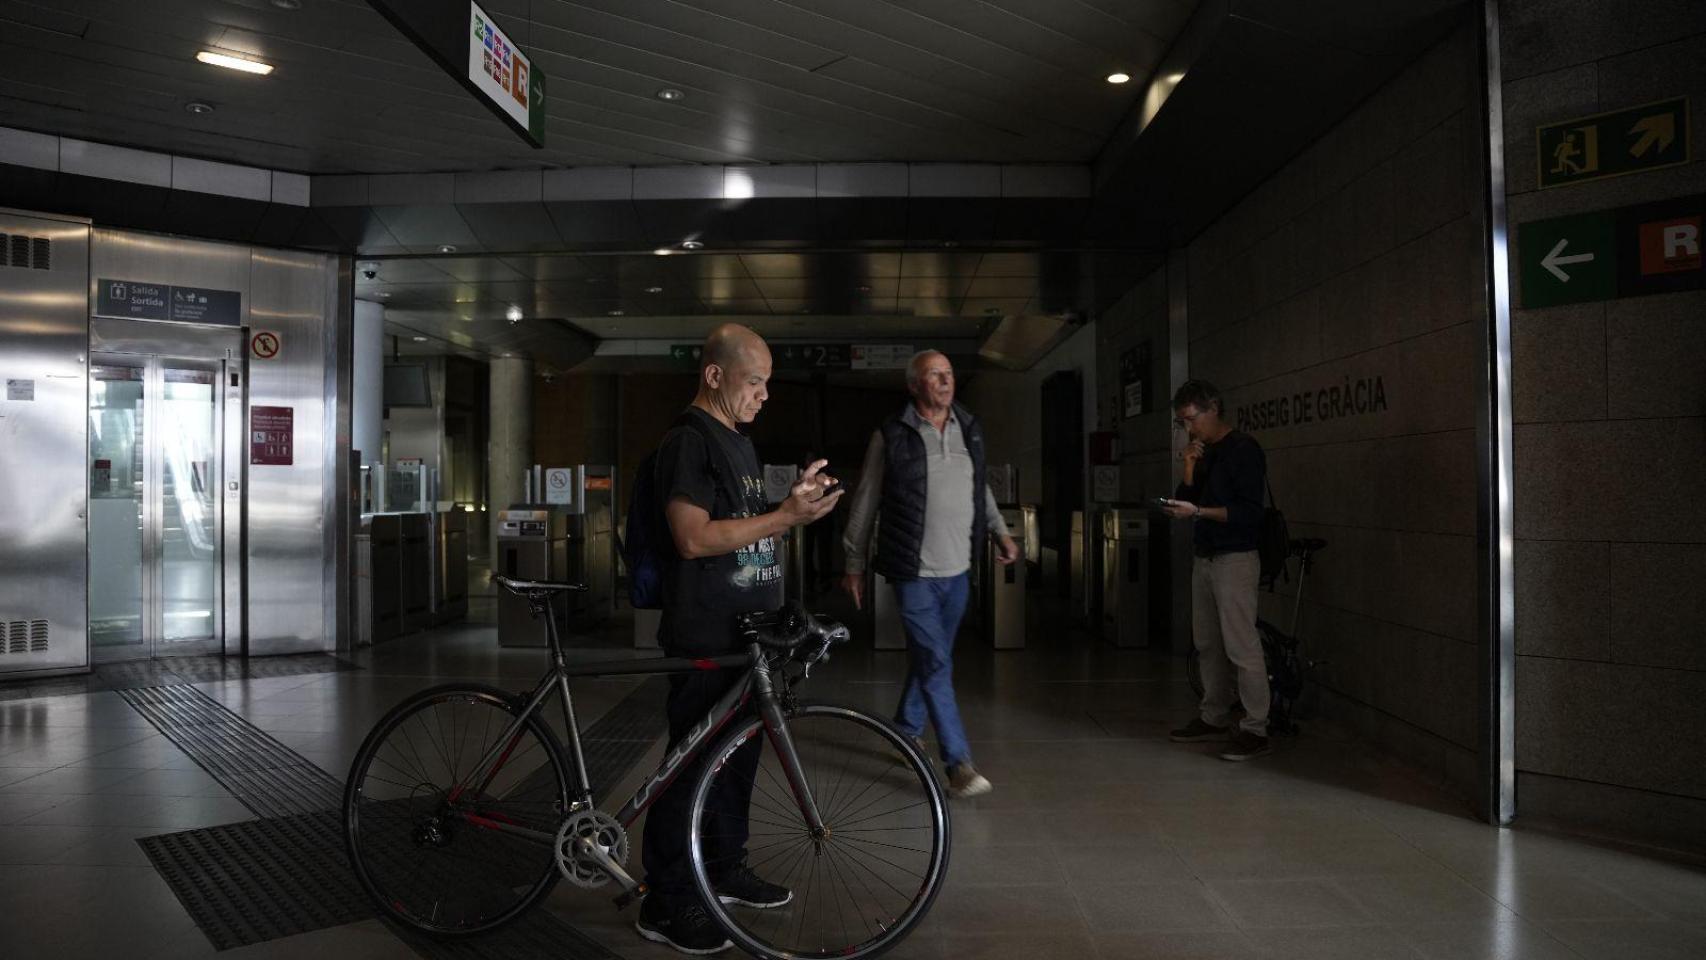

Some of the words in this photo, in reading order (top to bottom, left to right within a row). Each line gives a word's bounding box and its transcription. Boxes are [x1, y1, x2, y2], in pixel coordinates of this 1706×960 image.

[518, 63, 528, 96] R
[1663, 224, 1699, 258] R
[131, 285, 159, 297] Salida
[131, 297, 163, 307] Sortida
[815, 346, 827, 367] 2
[1237, 397, 1289, 431] PASSEIG
[1293, 391, 1312, 424] DE
[1317, 376, 1388, 421] GRÀCIA
